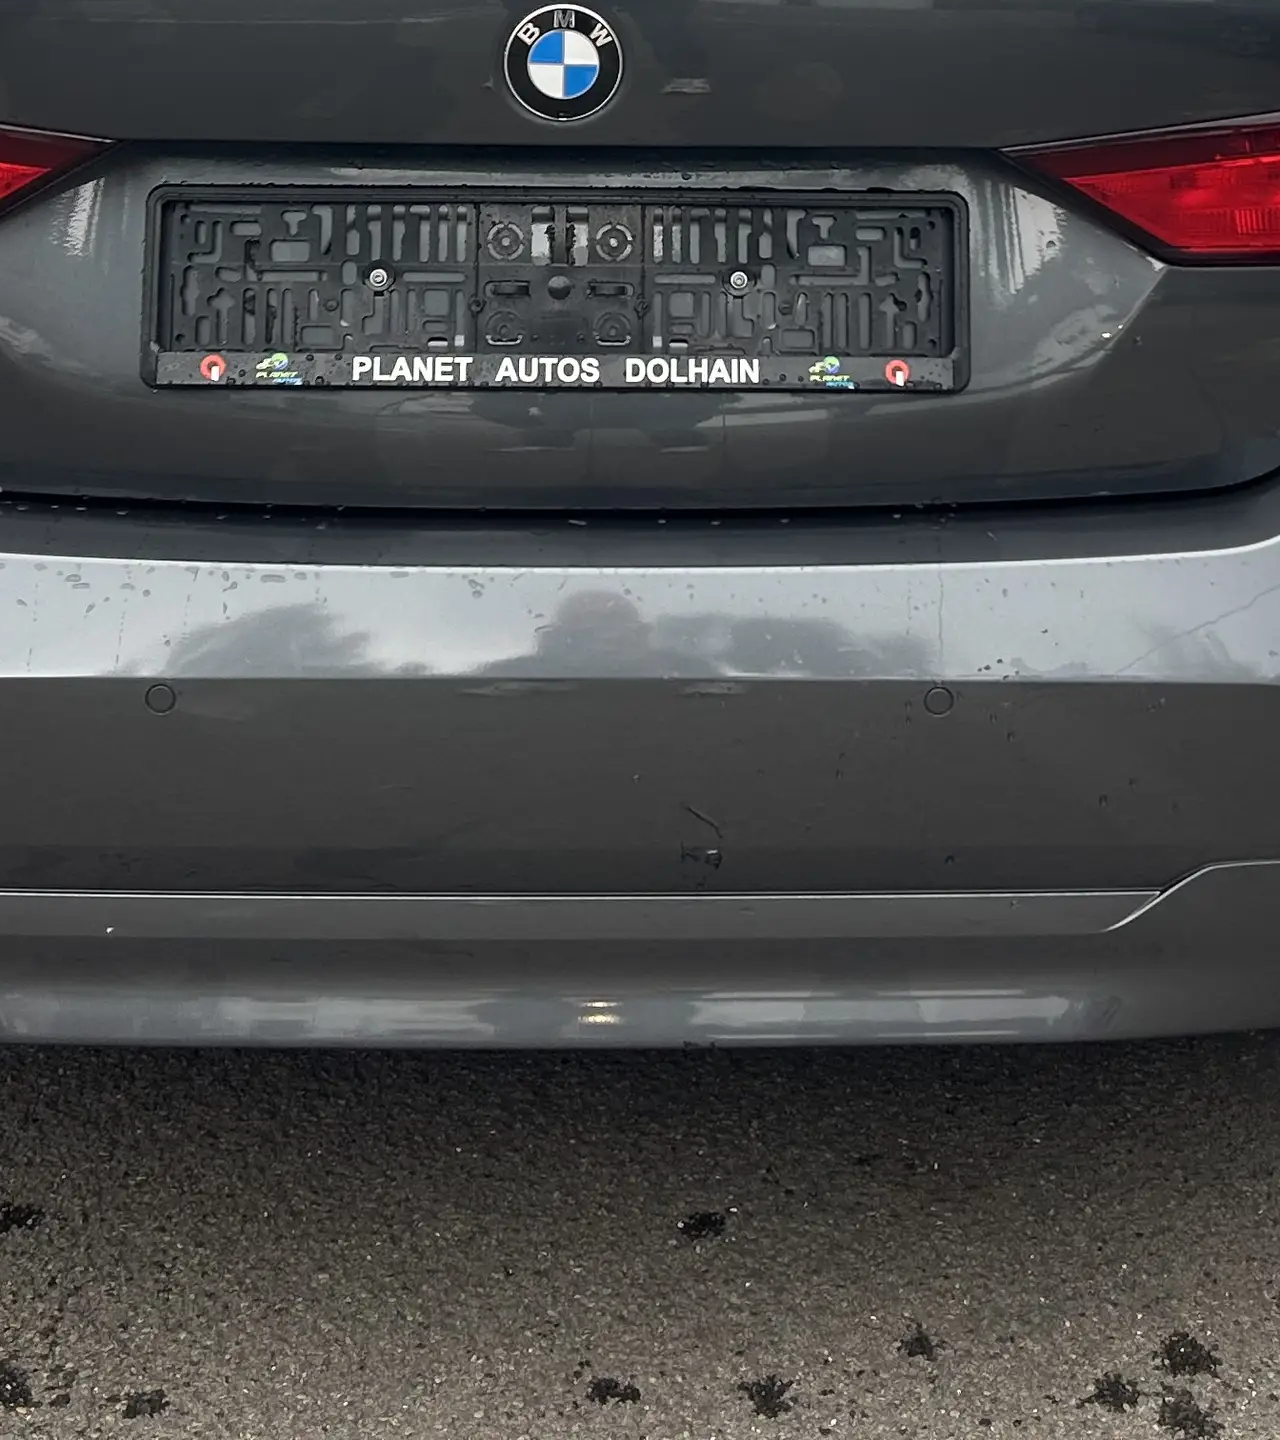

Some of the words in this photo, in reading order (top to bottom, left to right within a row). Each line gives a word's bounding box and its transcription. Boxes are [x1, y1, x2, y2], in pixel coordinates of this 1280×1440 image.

[517, 10, 613, 47] BMW
[352, 356, 473, 382] PLANET
[495, 357, 600, 383] AUTOS
[626, 357, 760, 384] DOLHAIN
